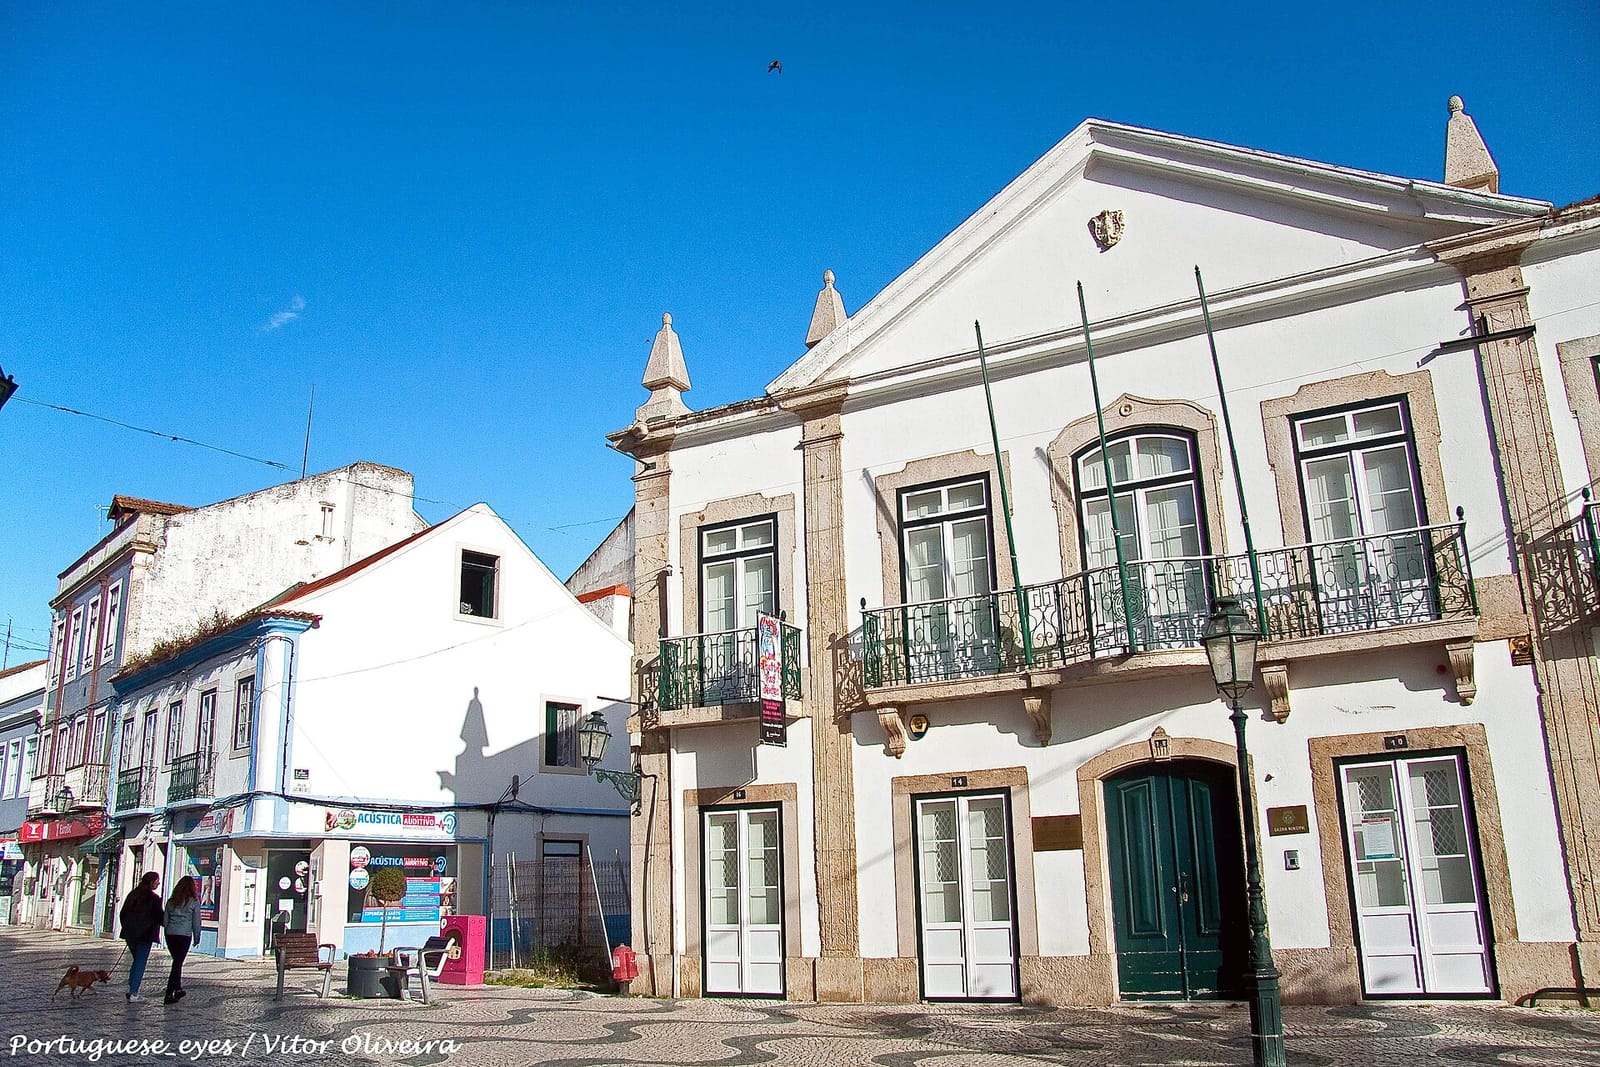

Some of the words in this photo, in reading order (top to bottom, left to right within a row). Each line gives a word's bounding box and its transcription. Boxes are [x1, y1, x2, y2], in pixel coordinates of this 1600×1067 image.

[1390, 738, 1403, 746] 10
[953, 778, 963, 786] 14
[358, 811, 402, 825] ACÚSTICA
[403, 817, 434, 826] AUDITIVO
[369, 856, 404, 866] ACÚSTICA
